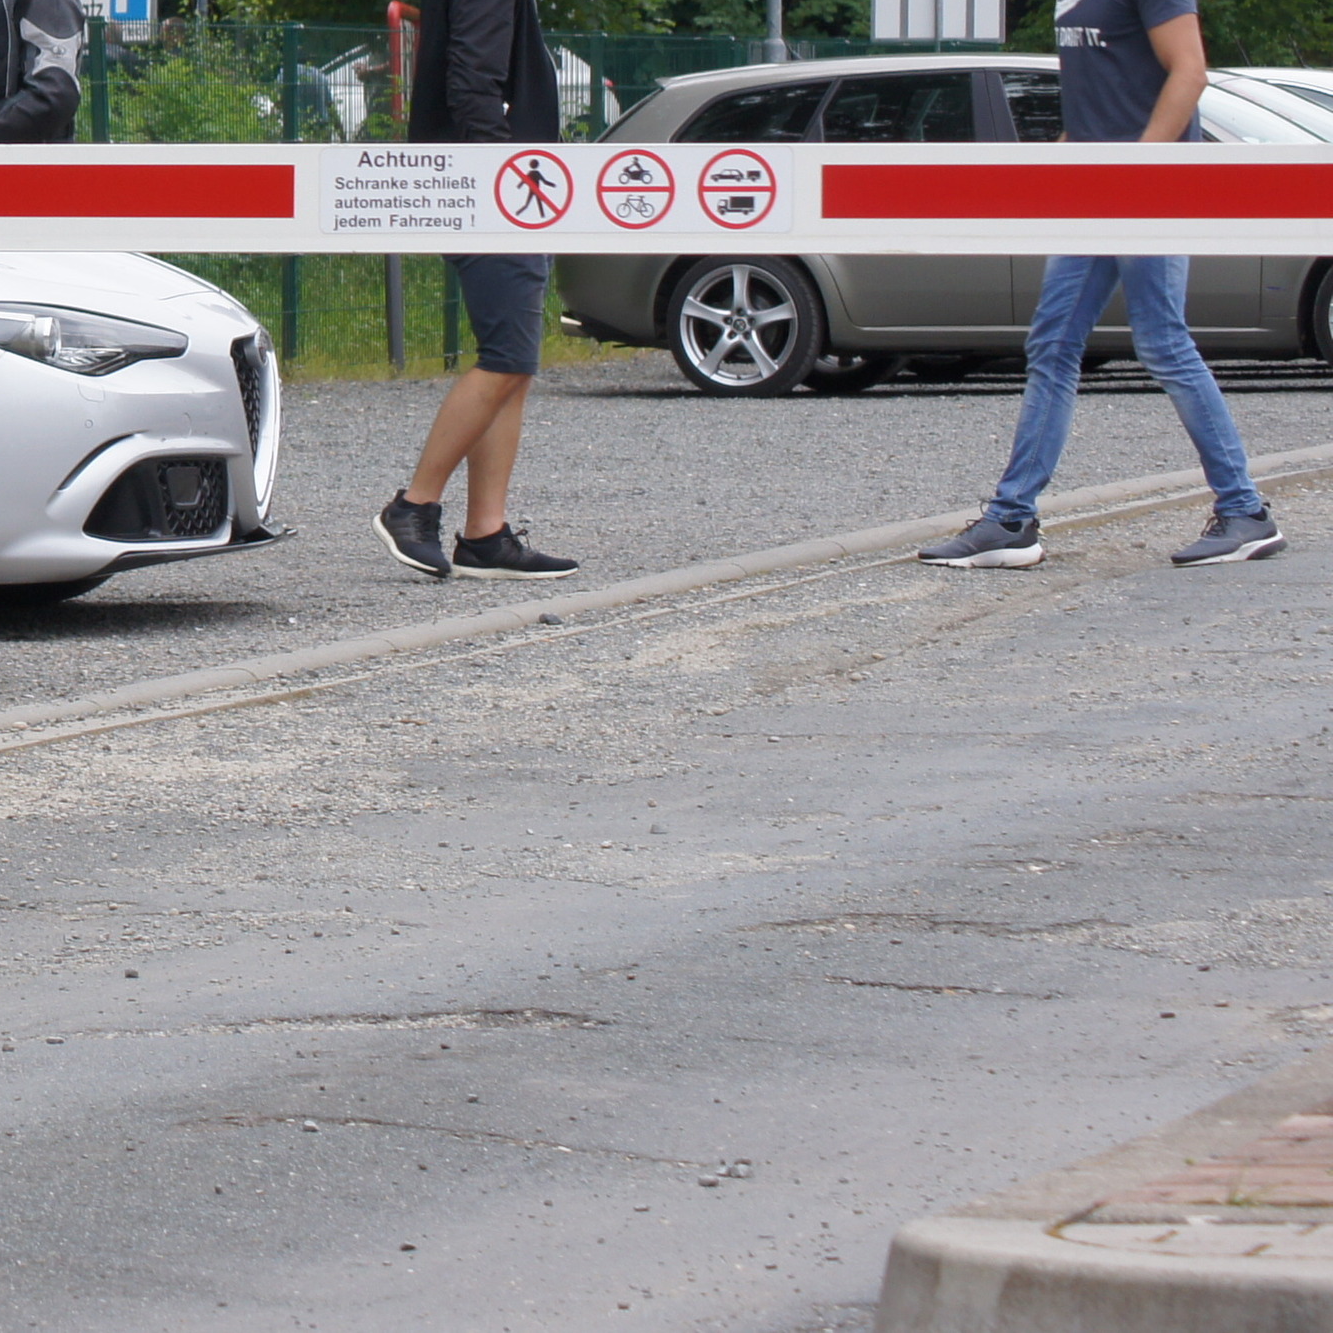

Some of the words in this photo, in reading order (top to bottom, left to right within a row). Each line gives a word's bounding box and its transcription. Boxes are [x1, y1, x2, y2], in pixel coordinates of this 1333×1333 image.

[357, 151, 453, 171] Achtung:
[334, 176, 408, 190] Schranke
[413, 176, 476, 190] schließt
[334, 195, 431, 209] automatisch
[437, 195, 476, 209] nach
[333, 214, 382, 231] jedem
[389, 214, 463, 231] Fahrzeug
